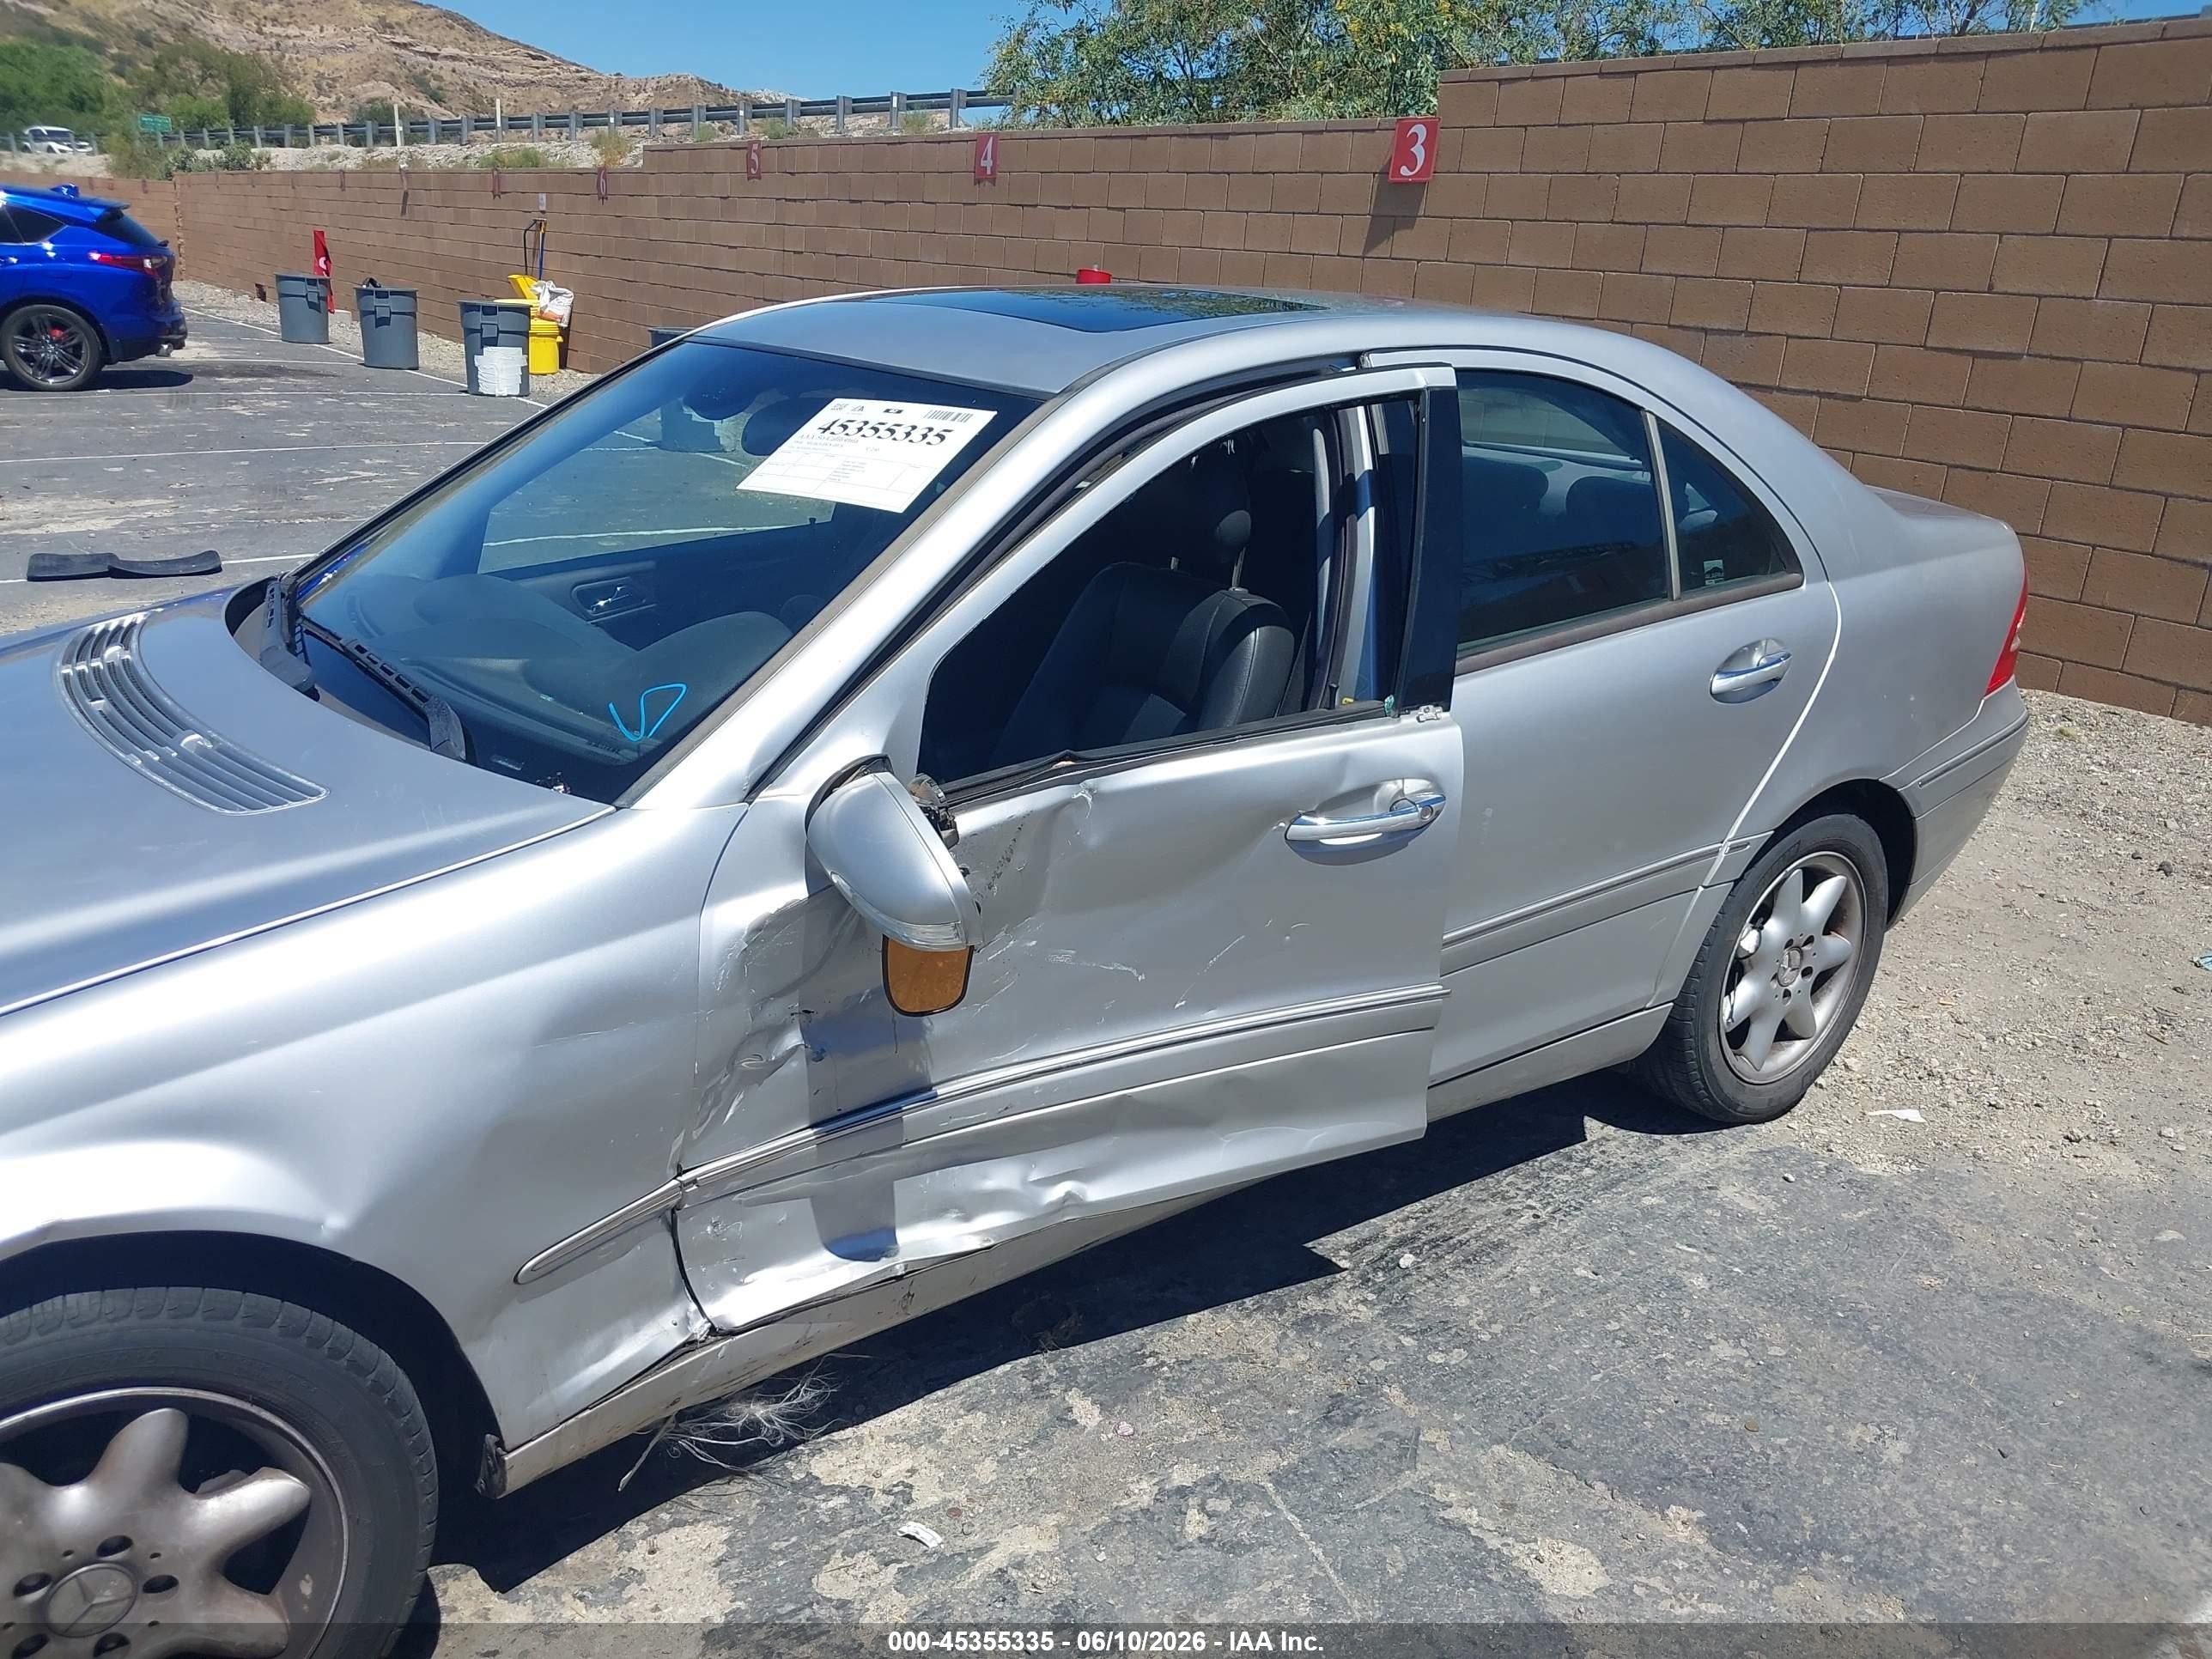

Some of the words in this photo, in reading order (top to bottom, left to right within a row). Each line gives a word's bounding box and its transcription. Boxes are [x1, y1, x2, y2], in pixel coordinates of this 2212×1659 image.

[750, 143, 759, 174] 5
[981, 137, 993, 174] 4
[1400, 124, 1427, 176] 3
[817, 418, 955, 446] 45355335
